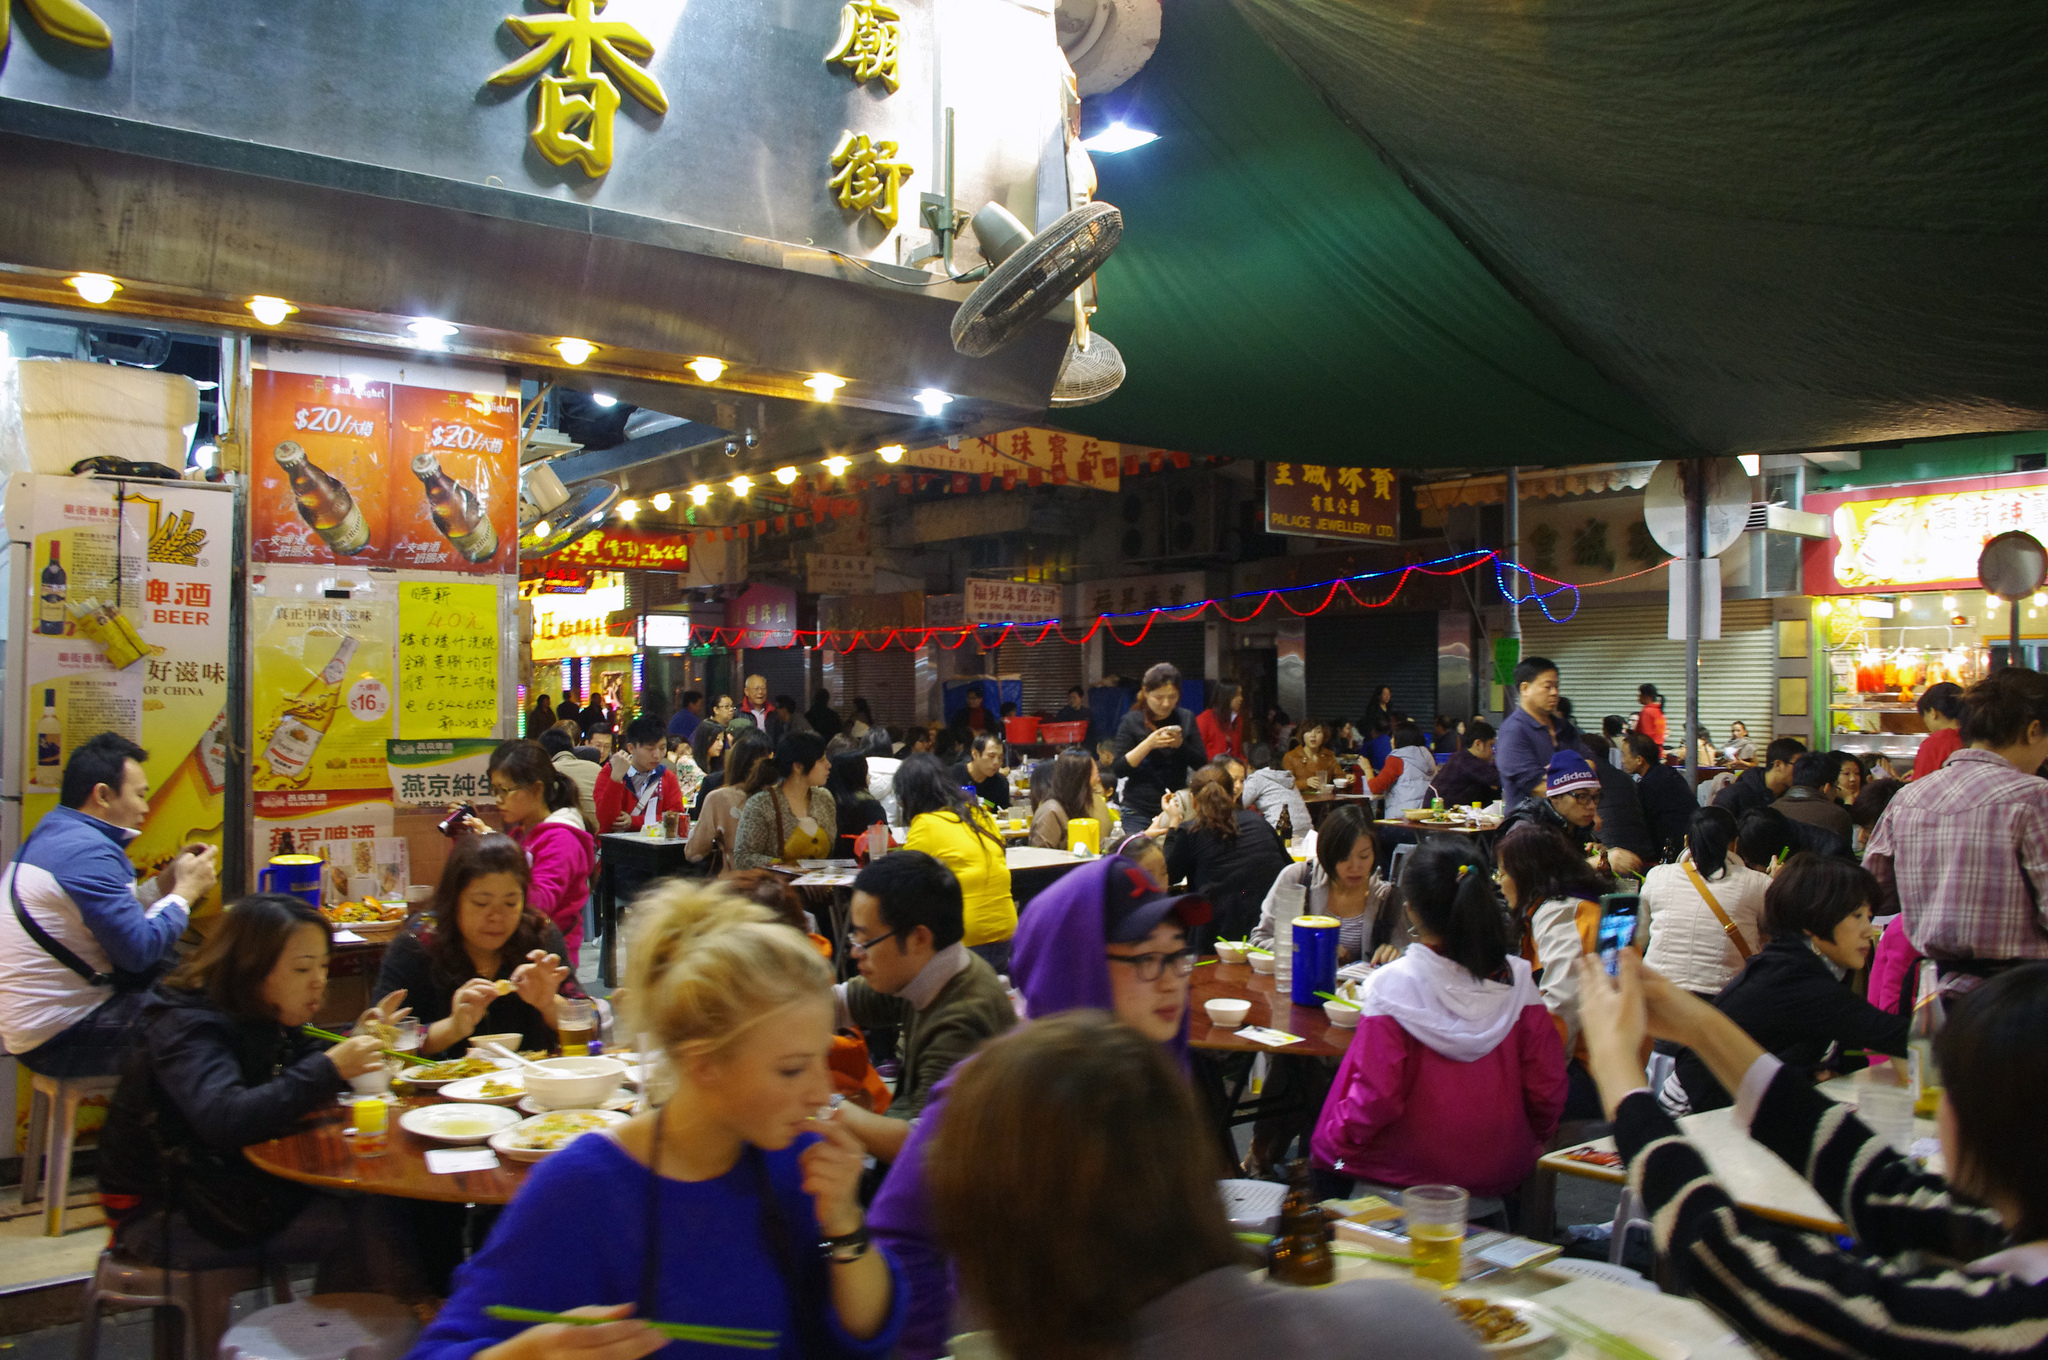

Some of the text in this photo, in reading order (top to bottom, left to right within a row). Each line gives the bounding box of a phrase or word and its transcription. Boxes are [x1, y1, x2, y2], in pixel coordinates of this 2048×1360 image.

[1271, 512, 1311, 529] PALACE
[1316, 518, 1372, 535] JEWELLERY
[153, 609, 210, 626] BEER
[149, 659, 226, 685] 好滋味
[143, 685, 204, 697] OF CHINA
[1553, 771, 1593, 786] adidas
